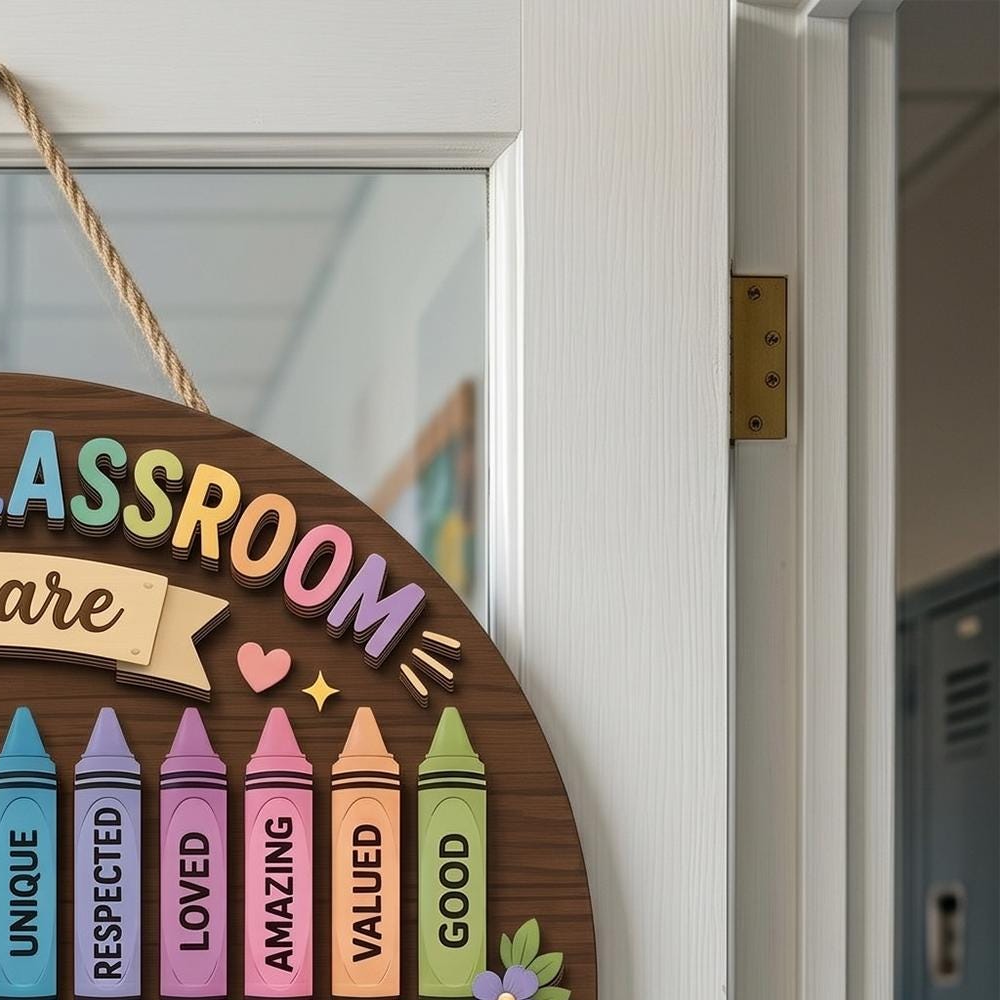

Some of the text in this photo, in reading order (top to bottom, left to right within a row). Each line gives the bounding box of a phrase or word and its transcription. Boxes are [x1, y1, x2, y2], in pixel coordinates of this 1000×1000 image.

[10, 829, 41, 957] UNIQUE
[94, 806, 122, 980] RESPECTED
[179, 831, 210, 951] LOVED
[264, 816, 294, 973] AMAZING
[352, 823, 382, 962] VALUED
[438, 833, 469, 949] GOOD
